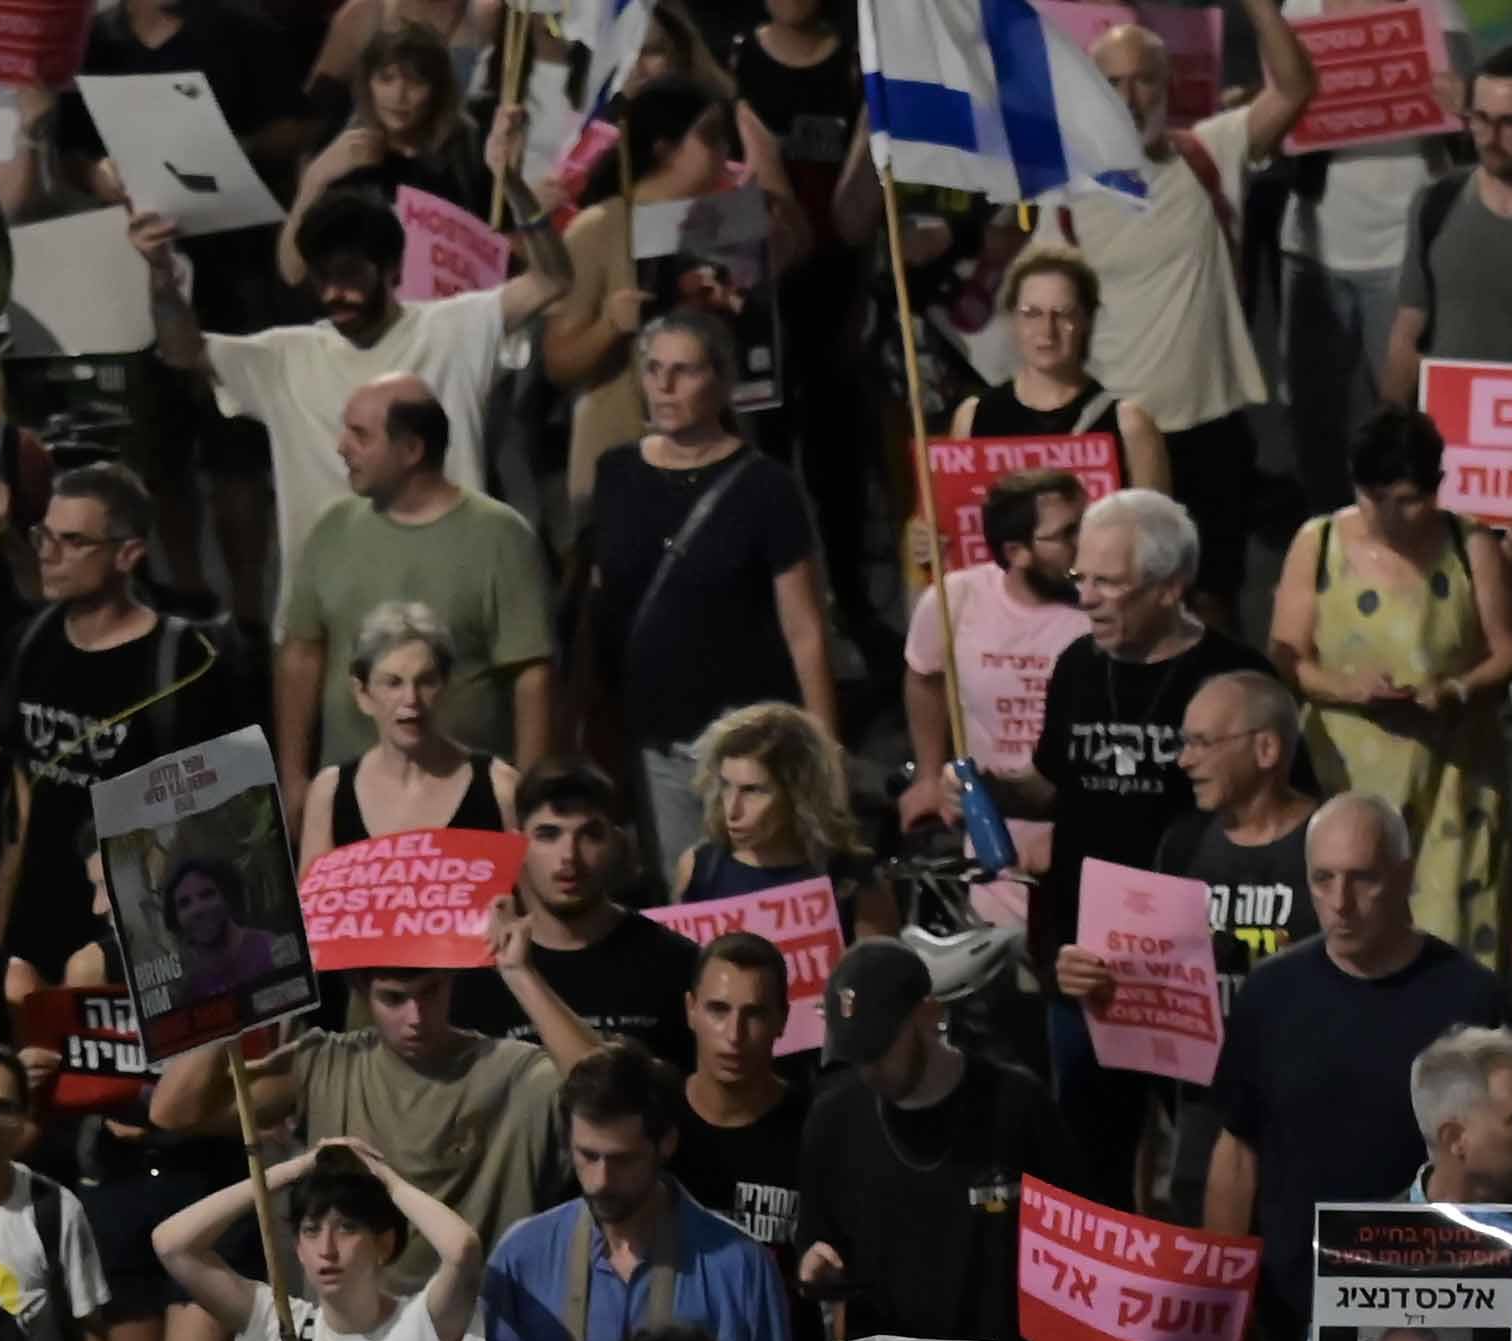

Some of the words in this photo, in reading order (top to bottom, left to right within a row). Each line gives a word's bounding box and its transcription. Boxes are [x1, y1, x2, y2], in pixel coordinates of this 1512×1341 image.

[389, 907, 489, 938] NOW
[759, 889, 830, 930] קול
[1234, 883, 1294, 928] למה
[1106, 930, 1175, 956] STOP
[1145, 960, 1208, 988] WAR
[1175, 1237, 1259, 1283] קול
[1030, 1247, 1102, 1311] אלי
[1419, 1282, 1496, 1311] אלכס
[1116, 1285, 1233, 1337] זועק
[1336, 1285, 1415, 1311] דנציג
